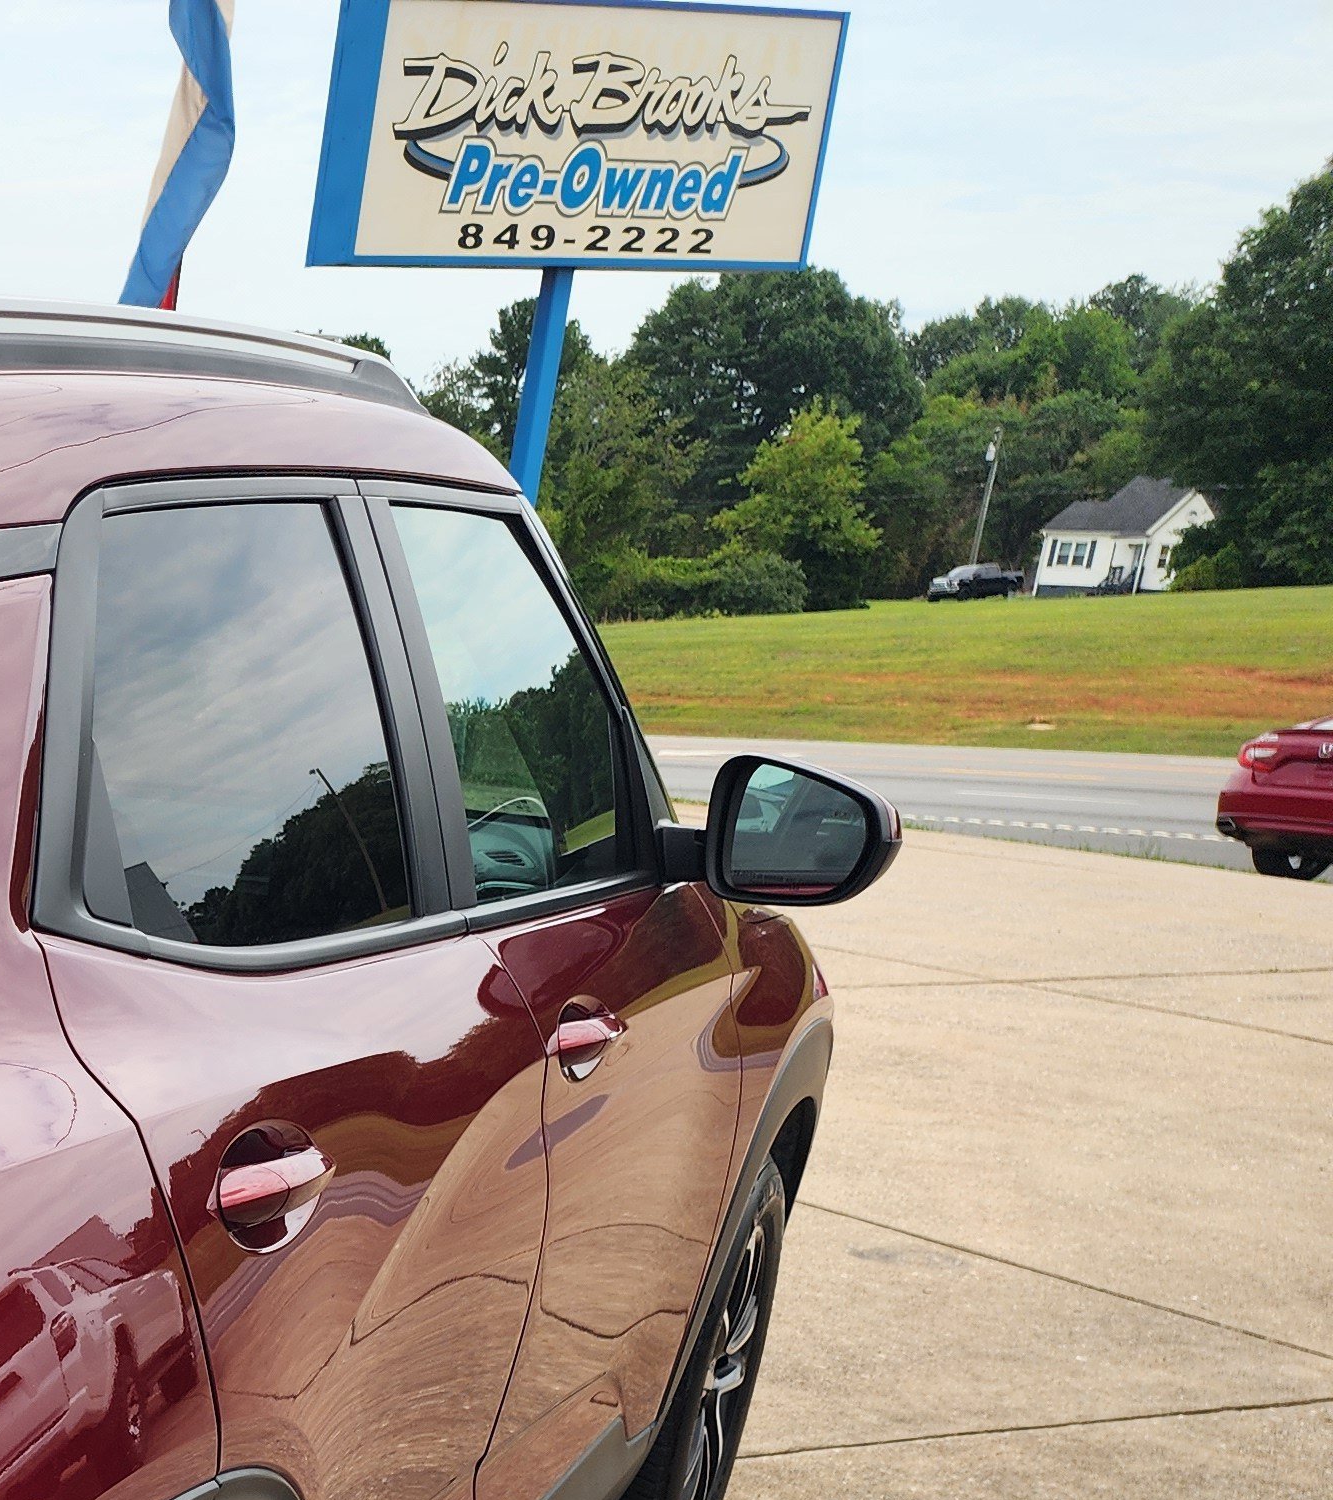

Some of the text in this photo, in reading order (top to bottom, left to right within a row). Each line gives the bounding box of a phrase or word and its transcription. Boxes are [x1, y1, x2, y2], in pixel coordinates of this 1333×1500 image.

[393, 41, 565, 140] Dick
[568, 51, 812, 139] Brooks
[439, 136, 750, 221] Pre-Owned
[456, 223, 714, 254] 849-2222
